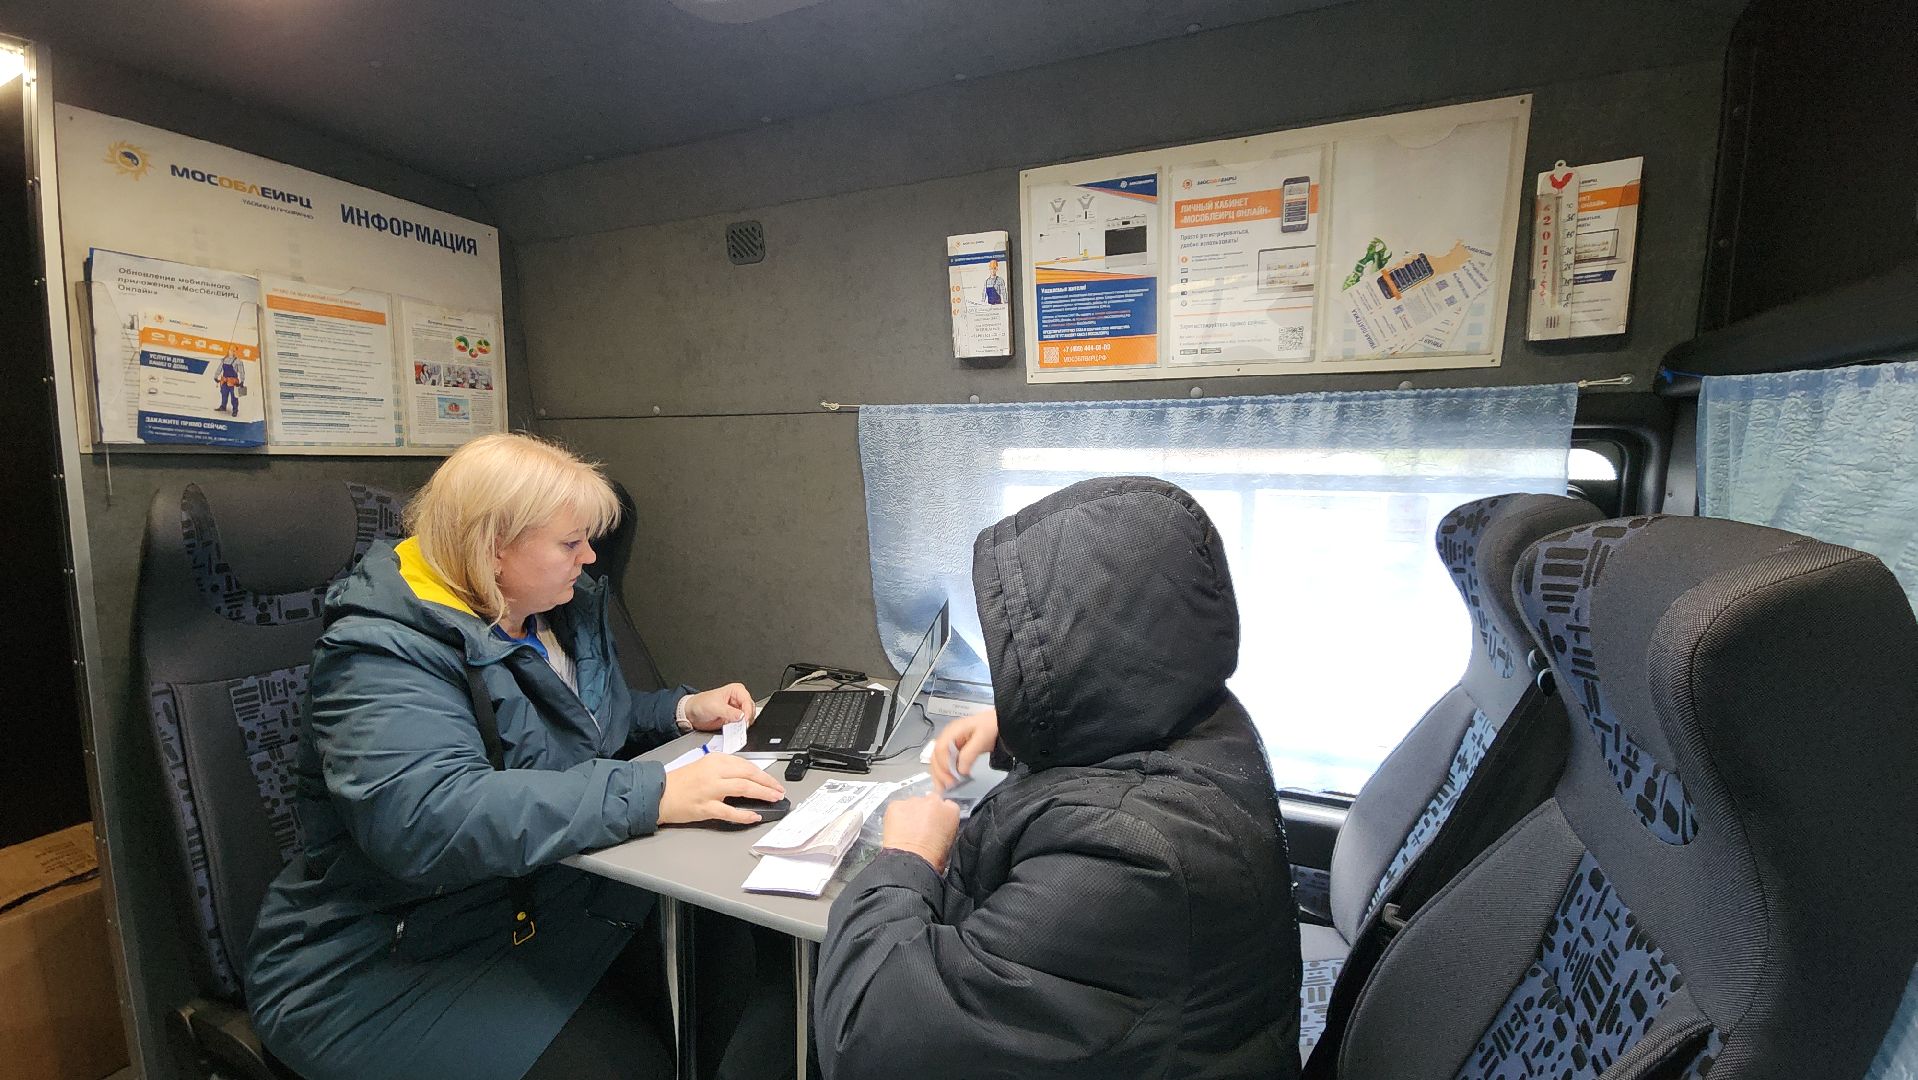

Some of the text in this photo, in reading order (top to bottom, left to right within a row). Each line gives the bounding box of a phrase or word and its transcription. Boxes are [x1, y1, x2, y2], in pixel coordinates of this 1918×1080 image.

[170, 164, 312, 209] МОСОБЛЕИРЦ
[1181, 197, 1248, 213] ЛИЧНЫЙ КАБИНЕТ
[340, 203, 478, 256] ИНФОРМАЦИЯ
[117, 277, 175, 290] приложения
[118, 267, 231, 291] Обновление мобильного
[117, 284, 158, 295] Онлайн»
[149, 353, 185, 364] УСЛУГИ ДЛЯ
[149, 360, 189, 371] ВАШЕГО ДОМА
[145, 416, 228, 431] ЗАКАЖИТЕ ПРЯМО СЕЙЧАС:
